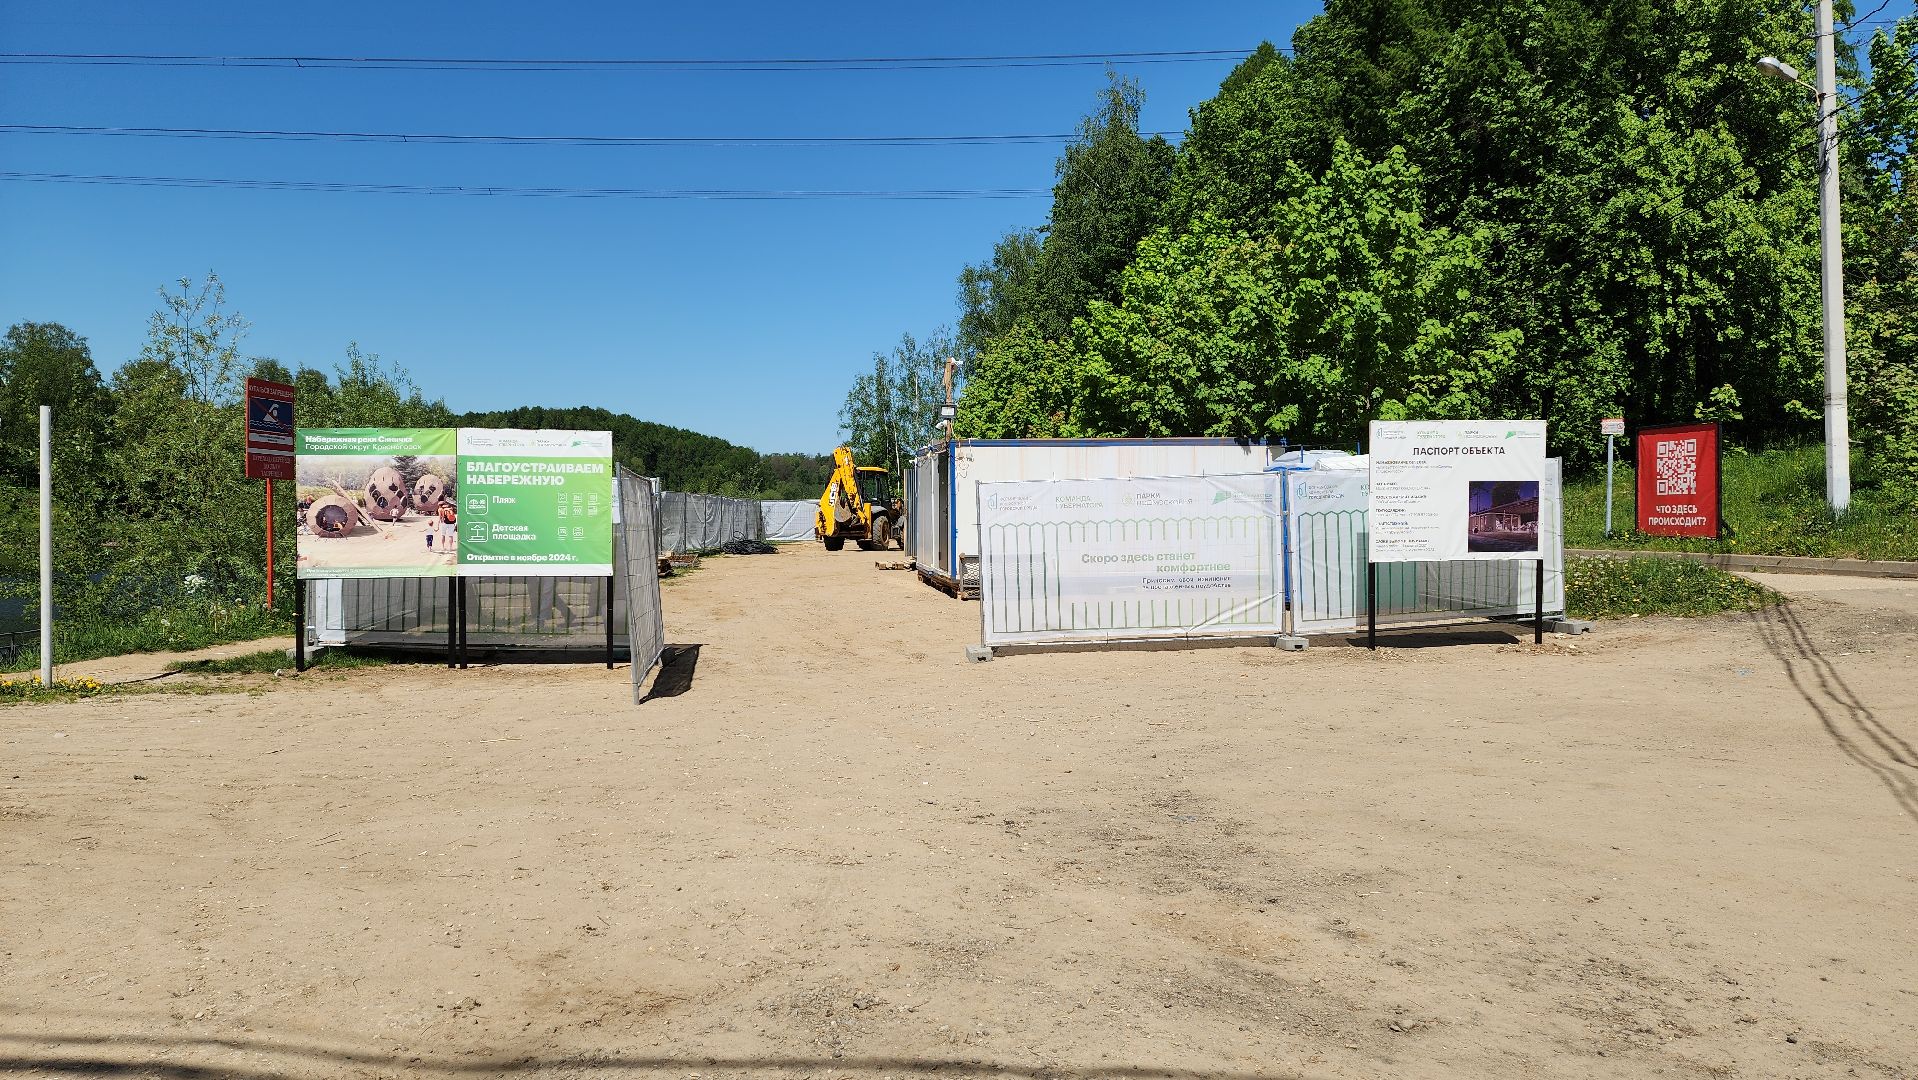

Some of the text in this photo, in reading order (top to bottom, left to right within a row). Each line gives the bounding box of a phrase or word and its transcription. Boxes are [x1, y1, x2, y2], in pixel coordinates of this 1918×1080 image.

[305, 435, 356, 444] Набережная
[305, 443, 347, 451] Городской
[1413, 446, 1505, 456] ПАСПОРТ ОБЪЕКТА
[466, 461, 604, 474] БЛАГОУСТРАИВАЕМ
[466, 474, 565, 486] НАБЕРЕЖНУЮ
[492, 495, 516, 504] Пляж
[1656, 504, 1698, 515] ЧТО ЗДЕСЬ
[1648, 516, 1707, 527] ПРОИСХОДИТ?
[492, 523, 529, 532] Детская
[492, 532, 537, 541] площадка
[466, 553, 509, 562] Открытие
[516, 553, 547, 561] ноябре
[1081, 551, 1196, 564] Скоро здесь станет
[1156, 562, 1232, 573] комфортнее
